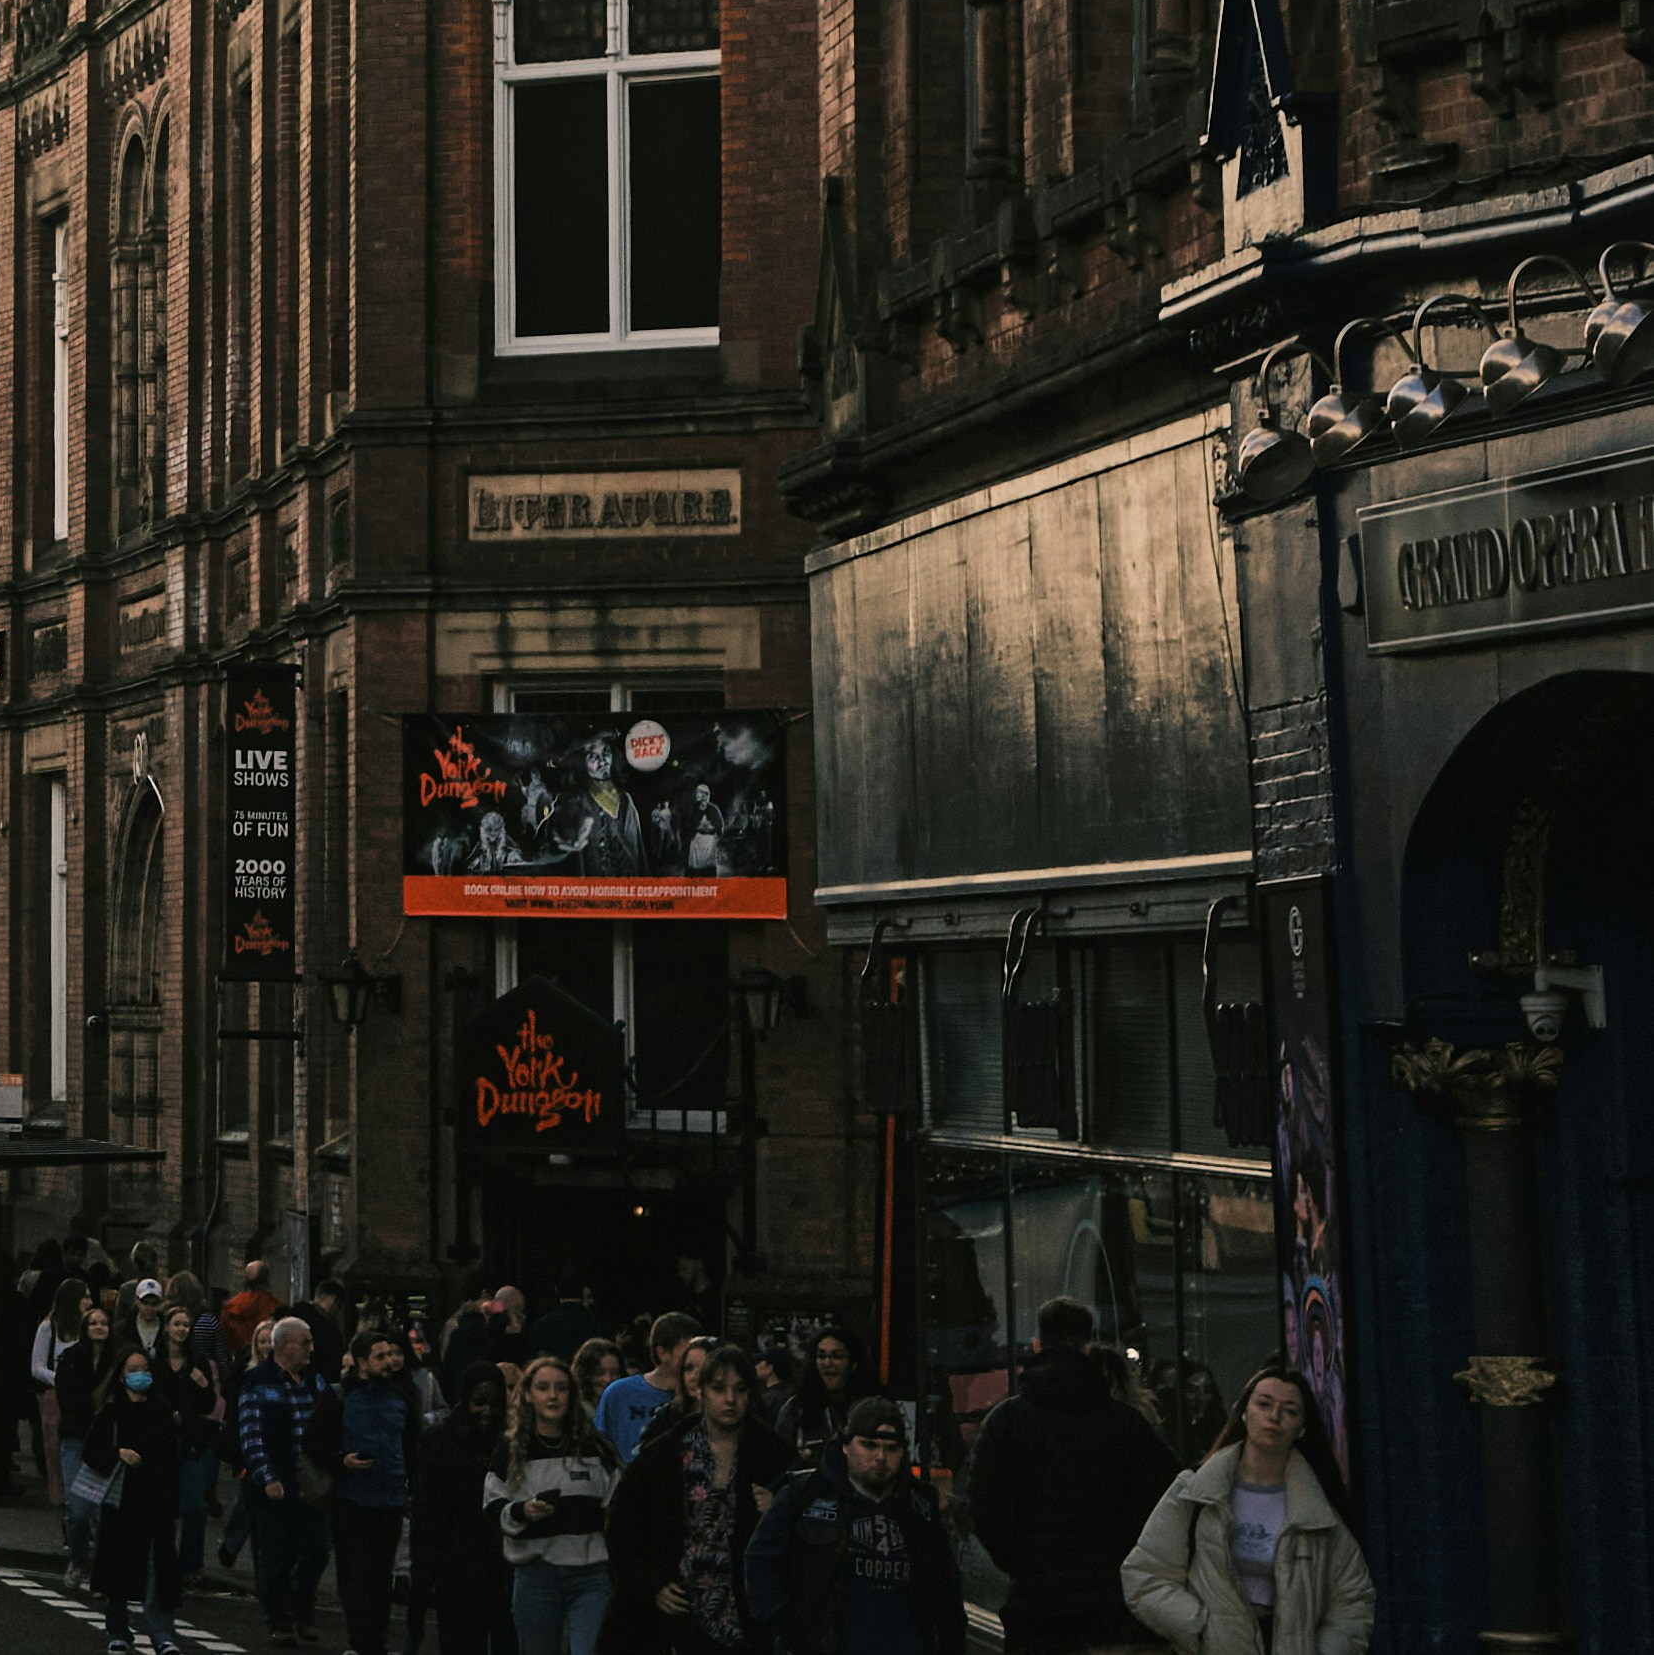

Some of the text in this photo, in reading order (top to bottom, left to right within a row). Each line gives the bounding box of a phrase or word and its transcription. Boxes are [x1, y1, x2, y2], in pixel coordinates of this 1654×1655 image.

[1397, 526, 1511, 611] GRAND
[1510, 501, 1632, 594] OPERA
[449, 725, 474, 755] the
[235, 749, 288, 770] LIVE
[434, 748, 492, 781] York
[233, 771, 289, 787] SHOWS
[420, 772, 507, 810] Dungeon
[247, 810, 288, 821] MINUTES
[233, 821, 289, 837] OF FUN
[234, 859, 286, 875] 2000
[234, 875, 287, 887] YEARS OF
[464, 884, 489, 896] BOOK
[547, 885, 560, 896] TO
[561, 886, 590, 897] AVOID
[234, 886, 288, 899] HISTORY
[516, 1008, 554, 1053] the
[496, 1044, 579, 1090] York
[476, 1076, 602, 1133] Dungeon
